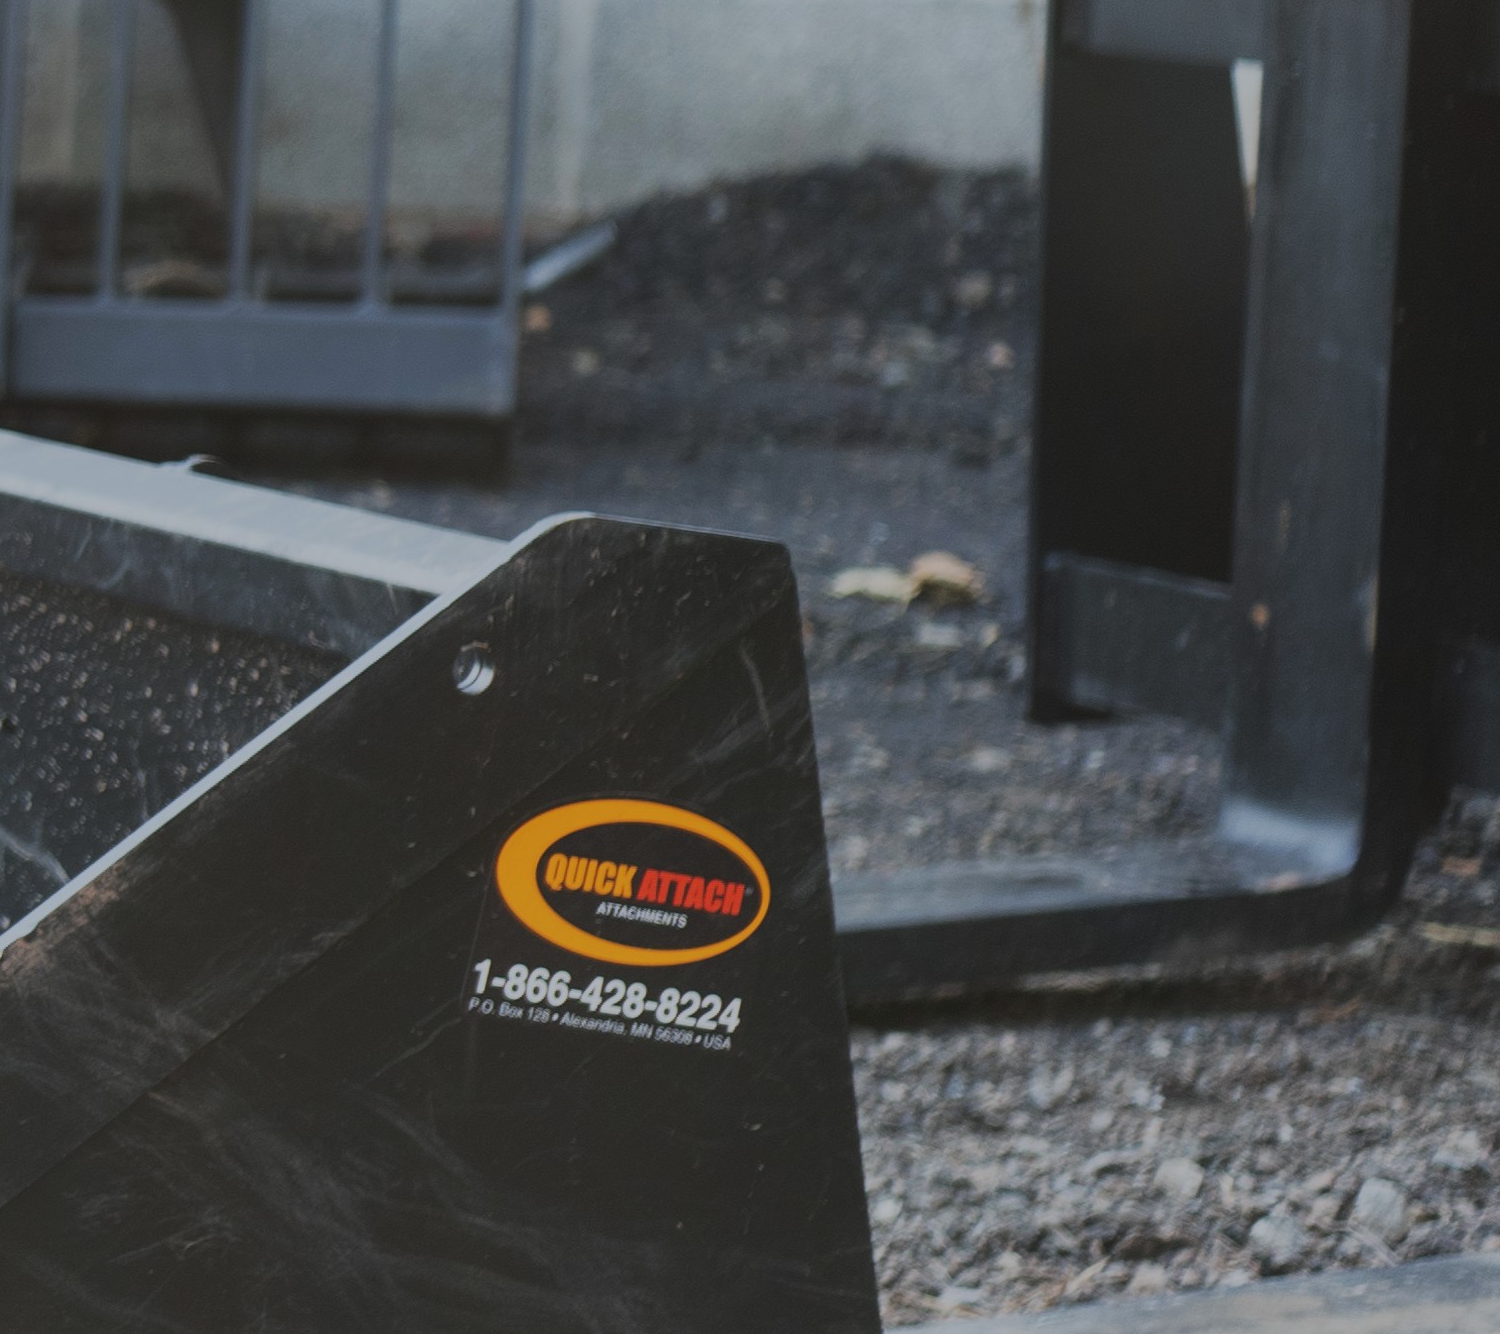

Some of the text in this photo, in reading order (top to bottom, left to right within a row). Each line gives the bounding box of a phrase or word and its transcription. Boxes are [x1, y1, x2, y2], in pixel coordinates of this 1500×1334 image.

[545, 854, 745, 916] QUICK ATTACH
[596, 903, 688, 928] ATTACHMENTS
[468, 997, 496, 1016] P.O.
[499, 1003, 523, 1021] Box
[630, 1021, 652, 1040] MN
[703, 1034, 731, 1051] USA
[473, 959, 742, 1032] 1-866-428-8224
